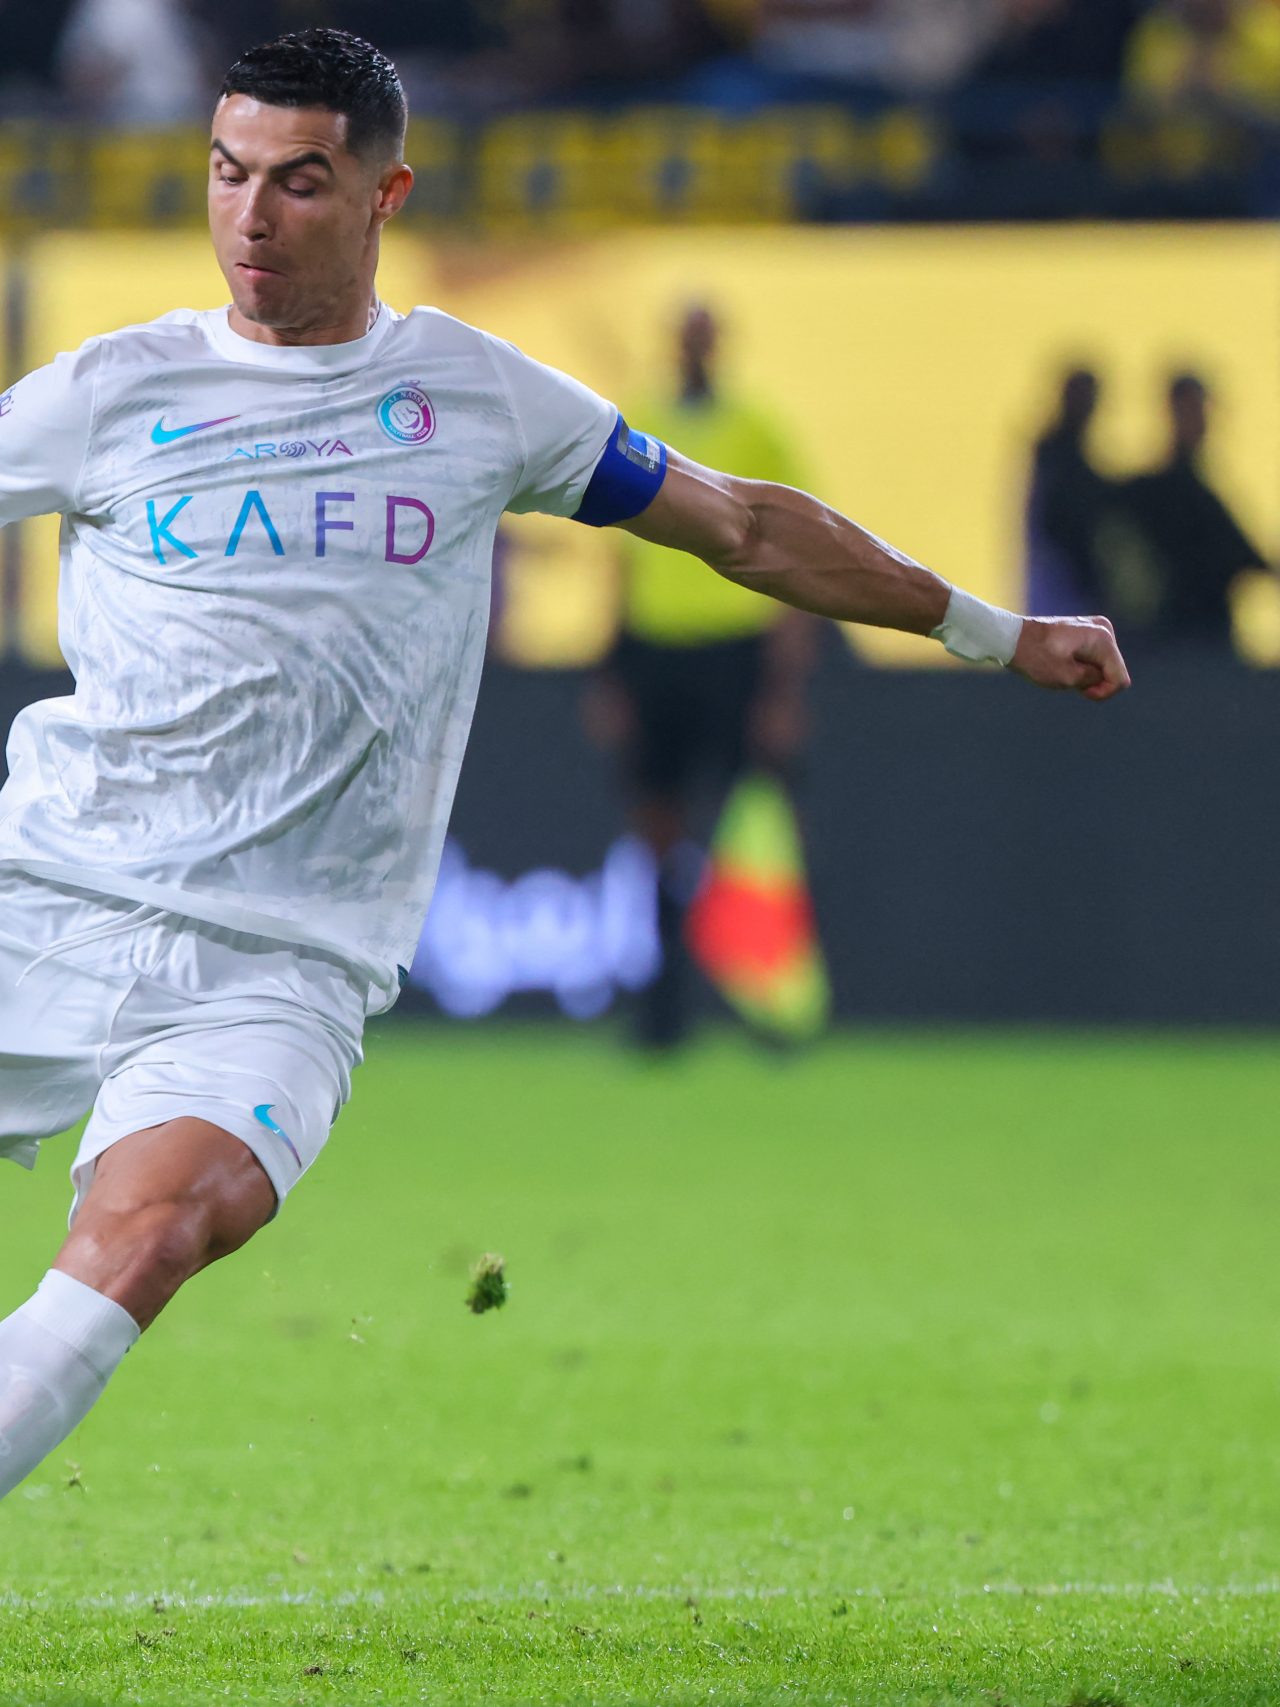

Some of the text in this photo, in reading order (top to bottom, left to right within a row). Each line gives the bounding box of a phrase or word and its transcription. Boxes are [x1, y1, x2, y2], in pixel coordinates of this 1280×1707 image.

[400, 391, 426, 408] NASSR
[225, 439, 354, 461] AROYA
[146, 490, 435, 566] KAFD
